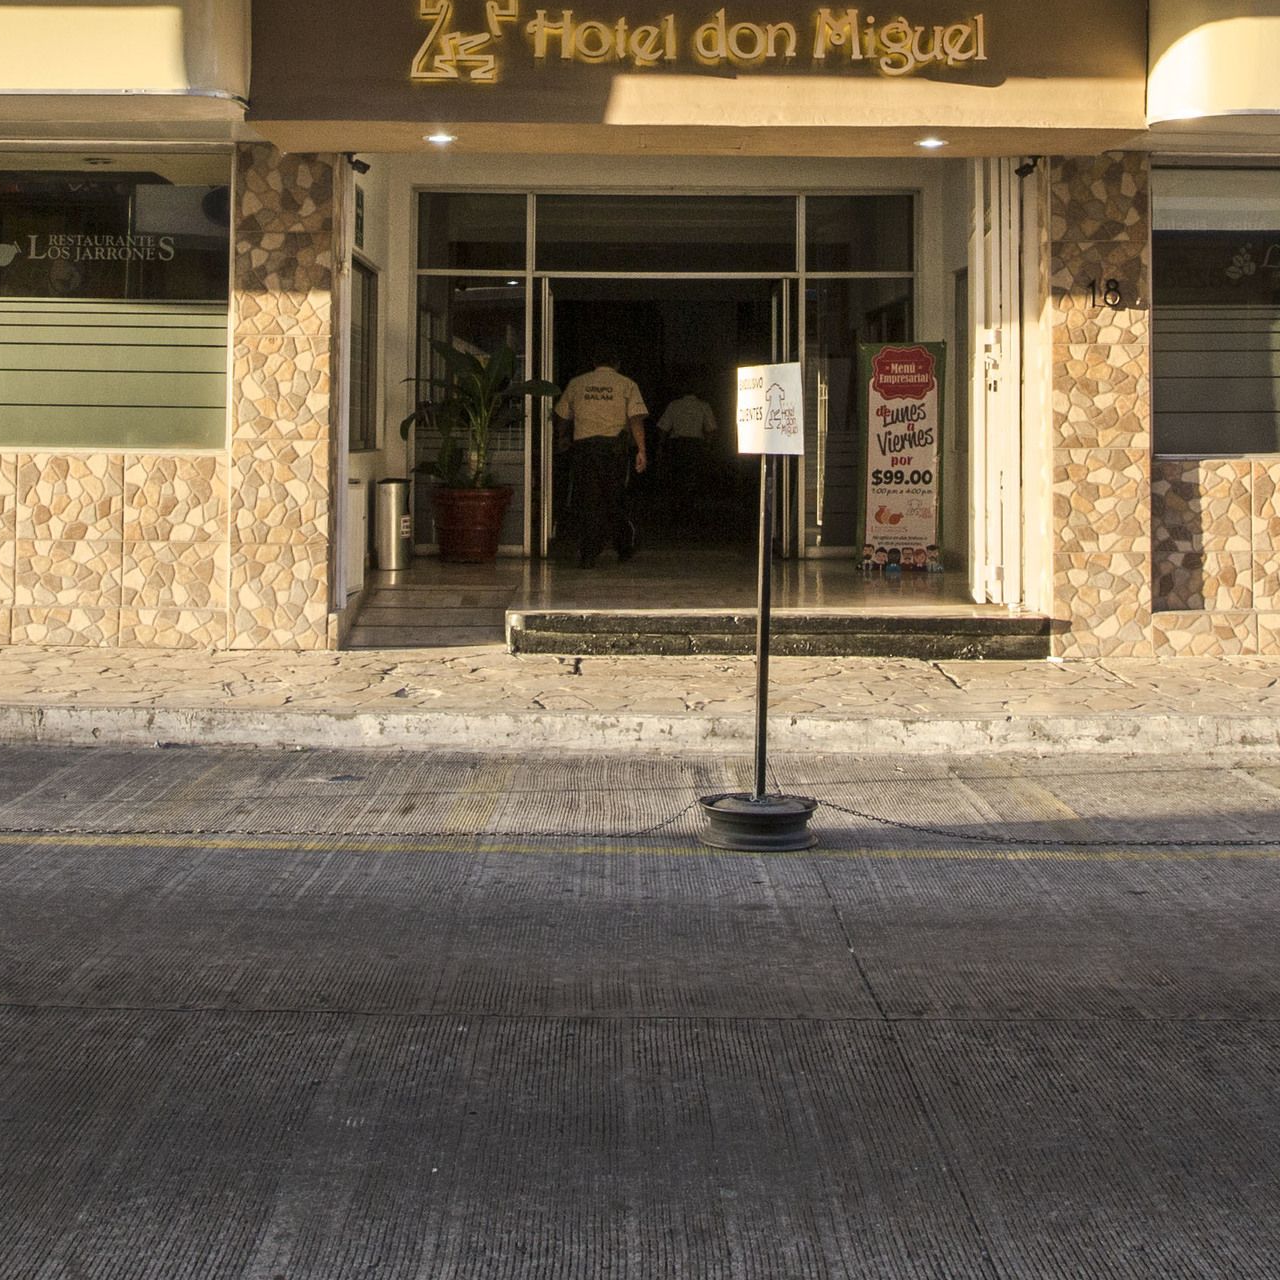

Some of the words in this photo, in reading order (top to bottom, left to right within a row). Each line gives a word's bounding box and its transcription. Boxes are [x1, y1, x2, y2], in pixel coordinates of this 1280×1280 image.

[527, 9, 677, 66] Hotel
[696, 8, 797, 60] don
[813, 8, 988, 77] Miguel
[48, 234, 156, 248] RESTAURANTE
[1087, 278, 1121, 308] 18
[880, 373, 929, 384] Empresarial
[883, 403, 927, 427] Lunes
[877, 427, 934, 456] Viernes
[891, 455, 913, 467] por
[871, 469, 933, 486] $99.00
